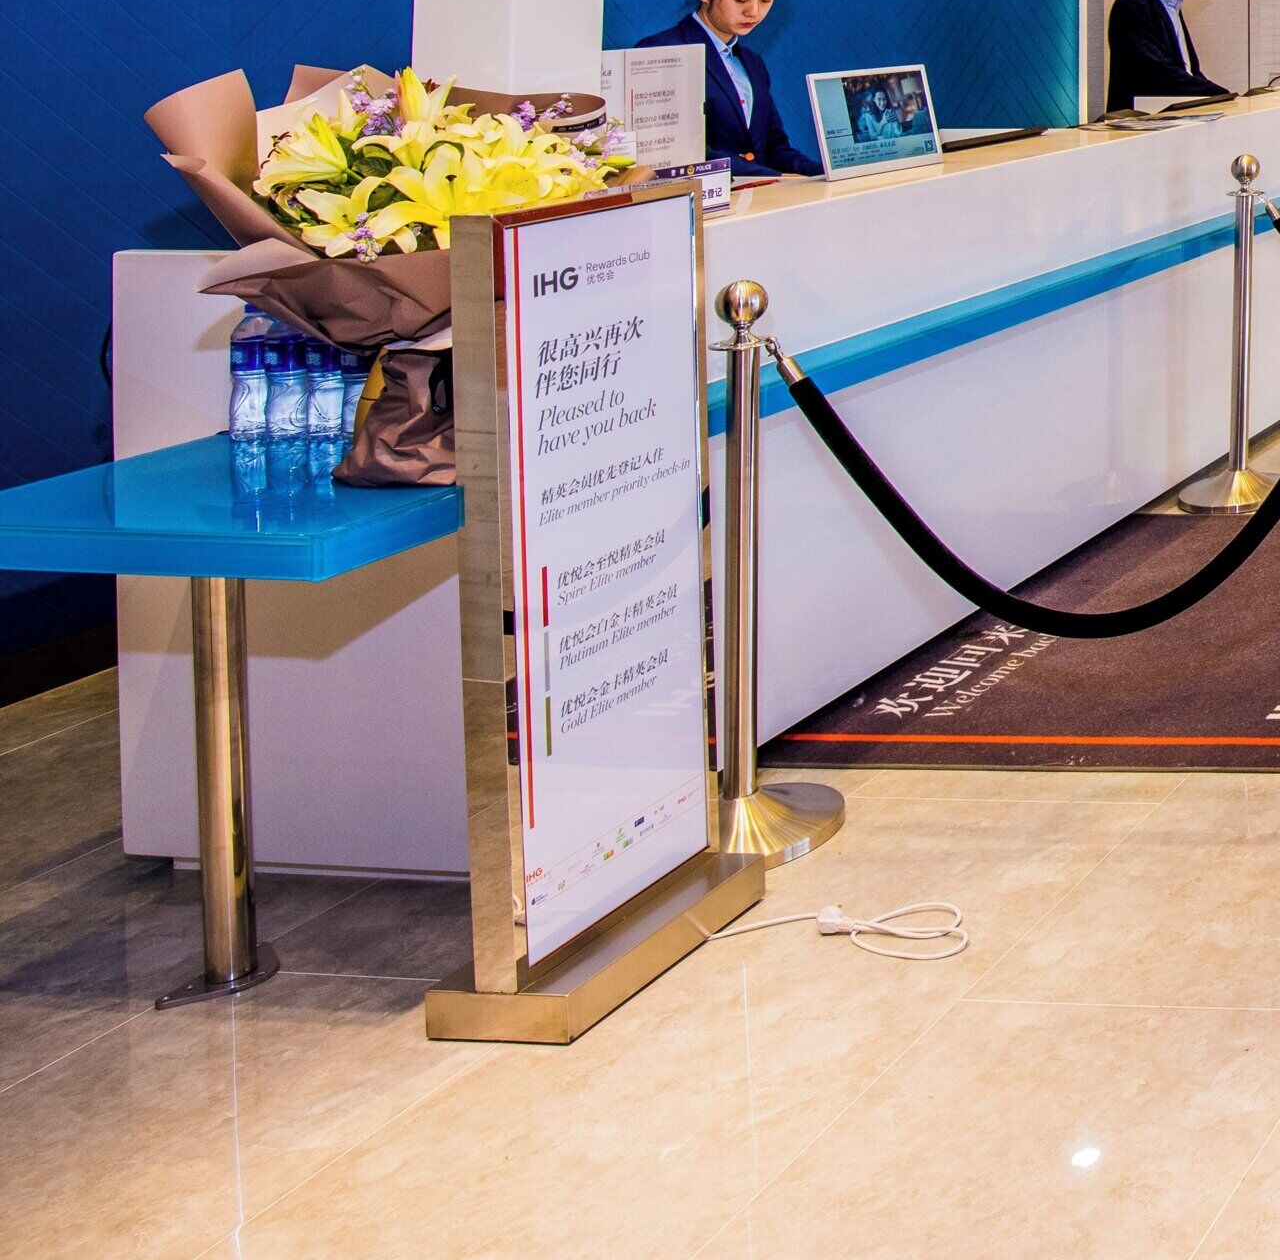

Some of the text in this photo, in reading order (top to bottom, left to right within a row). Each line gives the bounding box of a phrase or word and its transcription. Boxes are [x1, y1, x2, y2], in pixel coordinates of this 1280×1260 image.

[586, 255, 627, 273] Rewards
[629, 249, 650, 262] Club
[586, 269, 615, 285] 优悦会
[538, 316, 644, 367] 很高兴再次
[535, 350, 622, 399] 伴您同行
[537, 390, 625, 432] Pleased to
[537, 398, 657, 456] have you back
[539, 458, 691, 527] Elite member priority check-in
[541, 447, 665, 506] 精英会员优先登记入住
[557, 529, 665, 590] 优悦会至悦精英会员
[557, 553, 657, 607] Spire Elite member
[559, 583, 677, 654] 优悦会白金卡精英会员
[560, 604, 677, 671] Platinum Elite member
[561, 648, 668, 720] 优悦会金卡精英会员
[868, 624, 1029, 719] 欢迎回来
[923, 633, 1058, 718] Welcome bac
[560, 675, 657, 734] Gold Elite member
[526, 867, 543, 883] IHG
